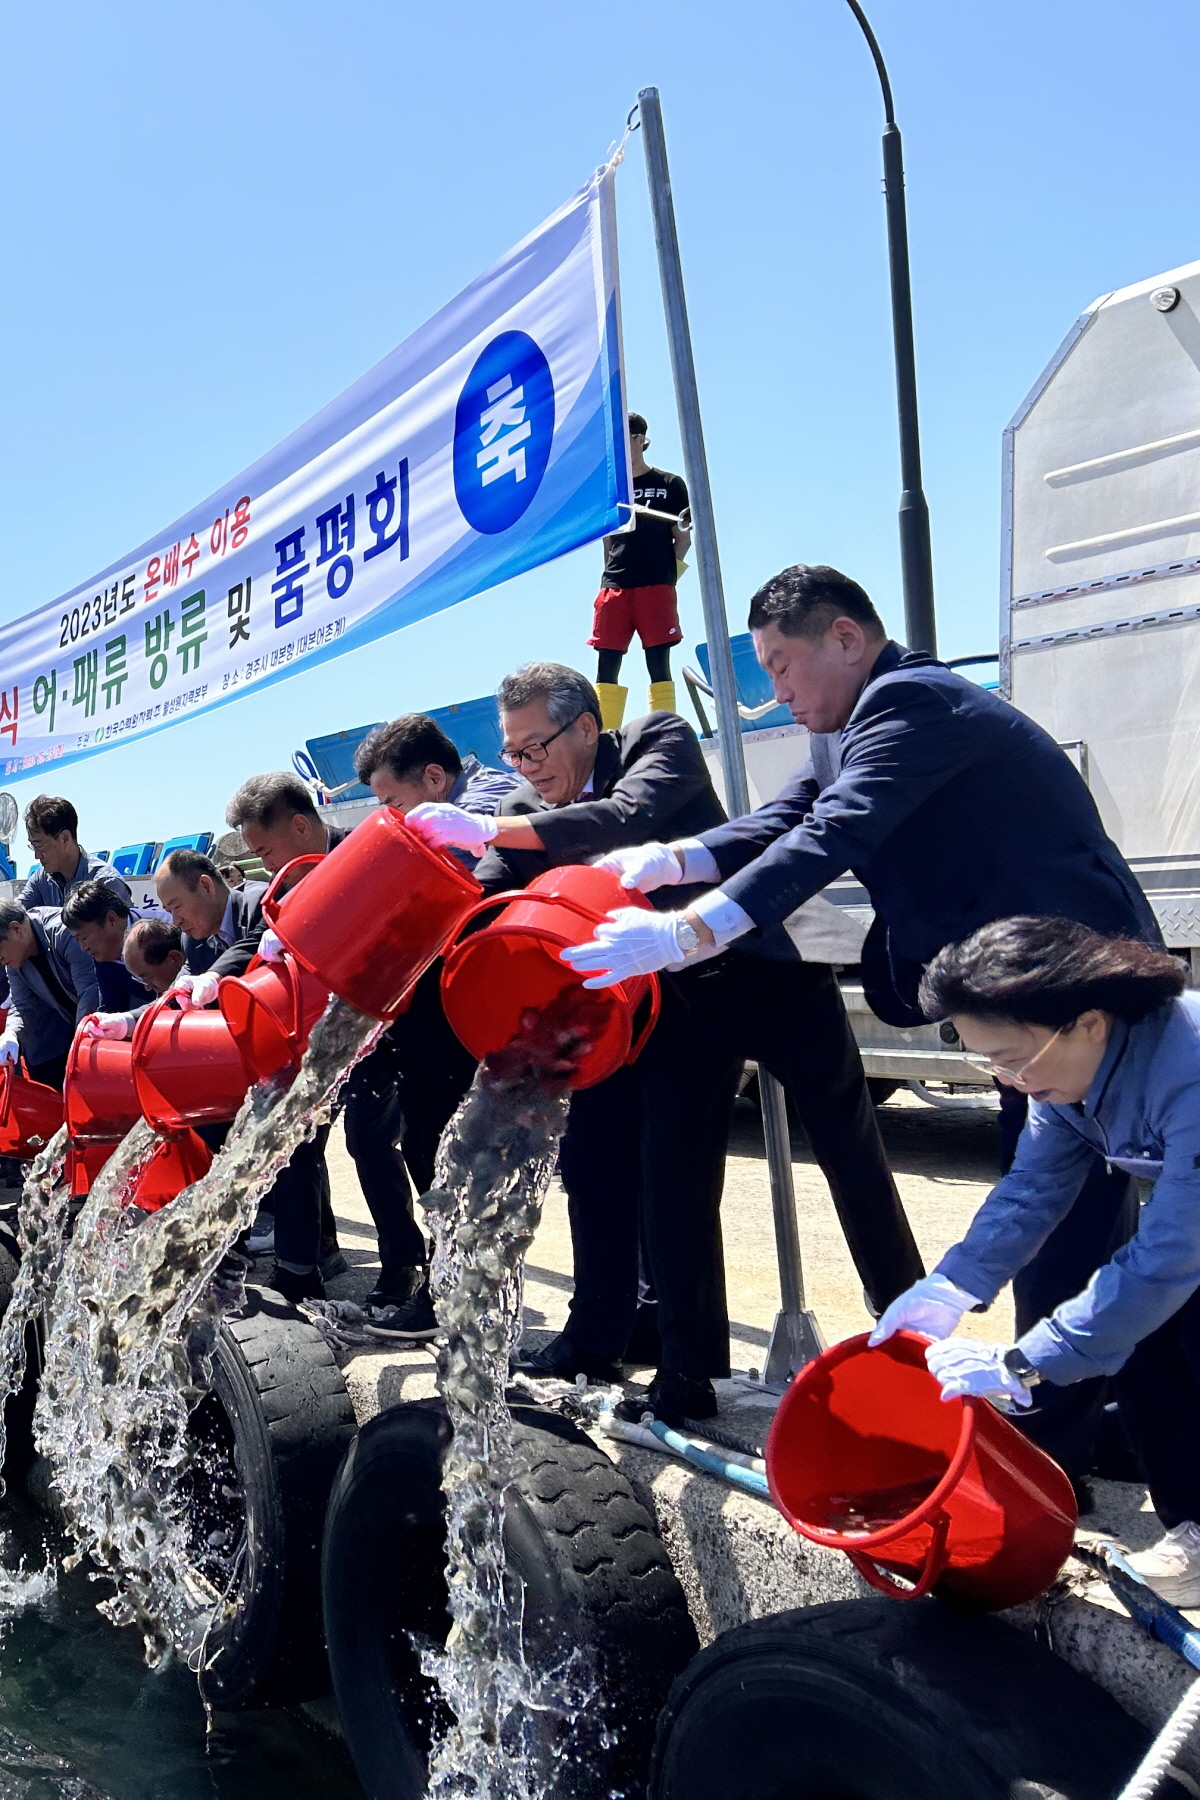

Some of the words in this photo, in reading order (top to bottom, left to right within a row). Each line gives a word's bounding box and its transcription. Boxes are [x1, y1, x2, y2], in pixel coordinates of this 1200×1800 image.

[475, 373, 532, 487] 축
[59, 573, 136, 648] 2023년도
[143, 532, 201, 603] 온배수
[210, 495, 251, 557] 이용
[144, 589, 209, 690] 방류
[227, 576, 252, 649] 및
[271, 456, 410, 629] 품평회
[245, 653, 269, 680] 경주시
[270, 640, 295, 667] 대본항
